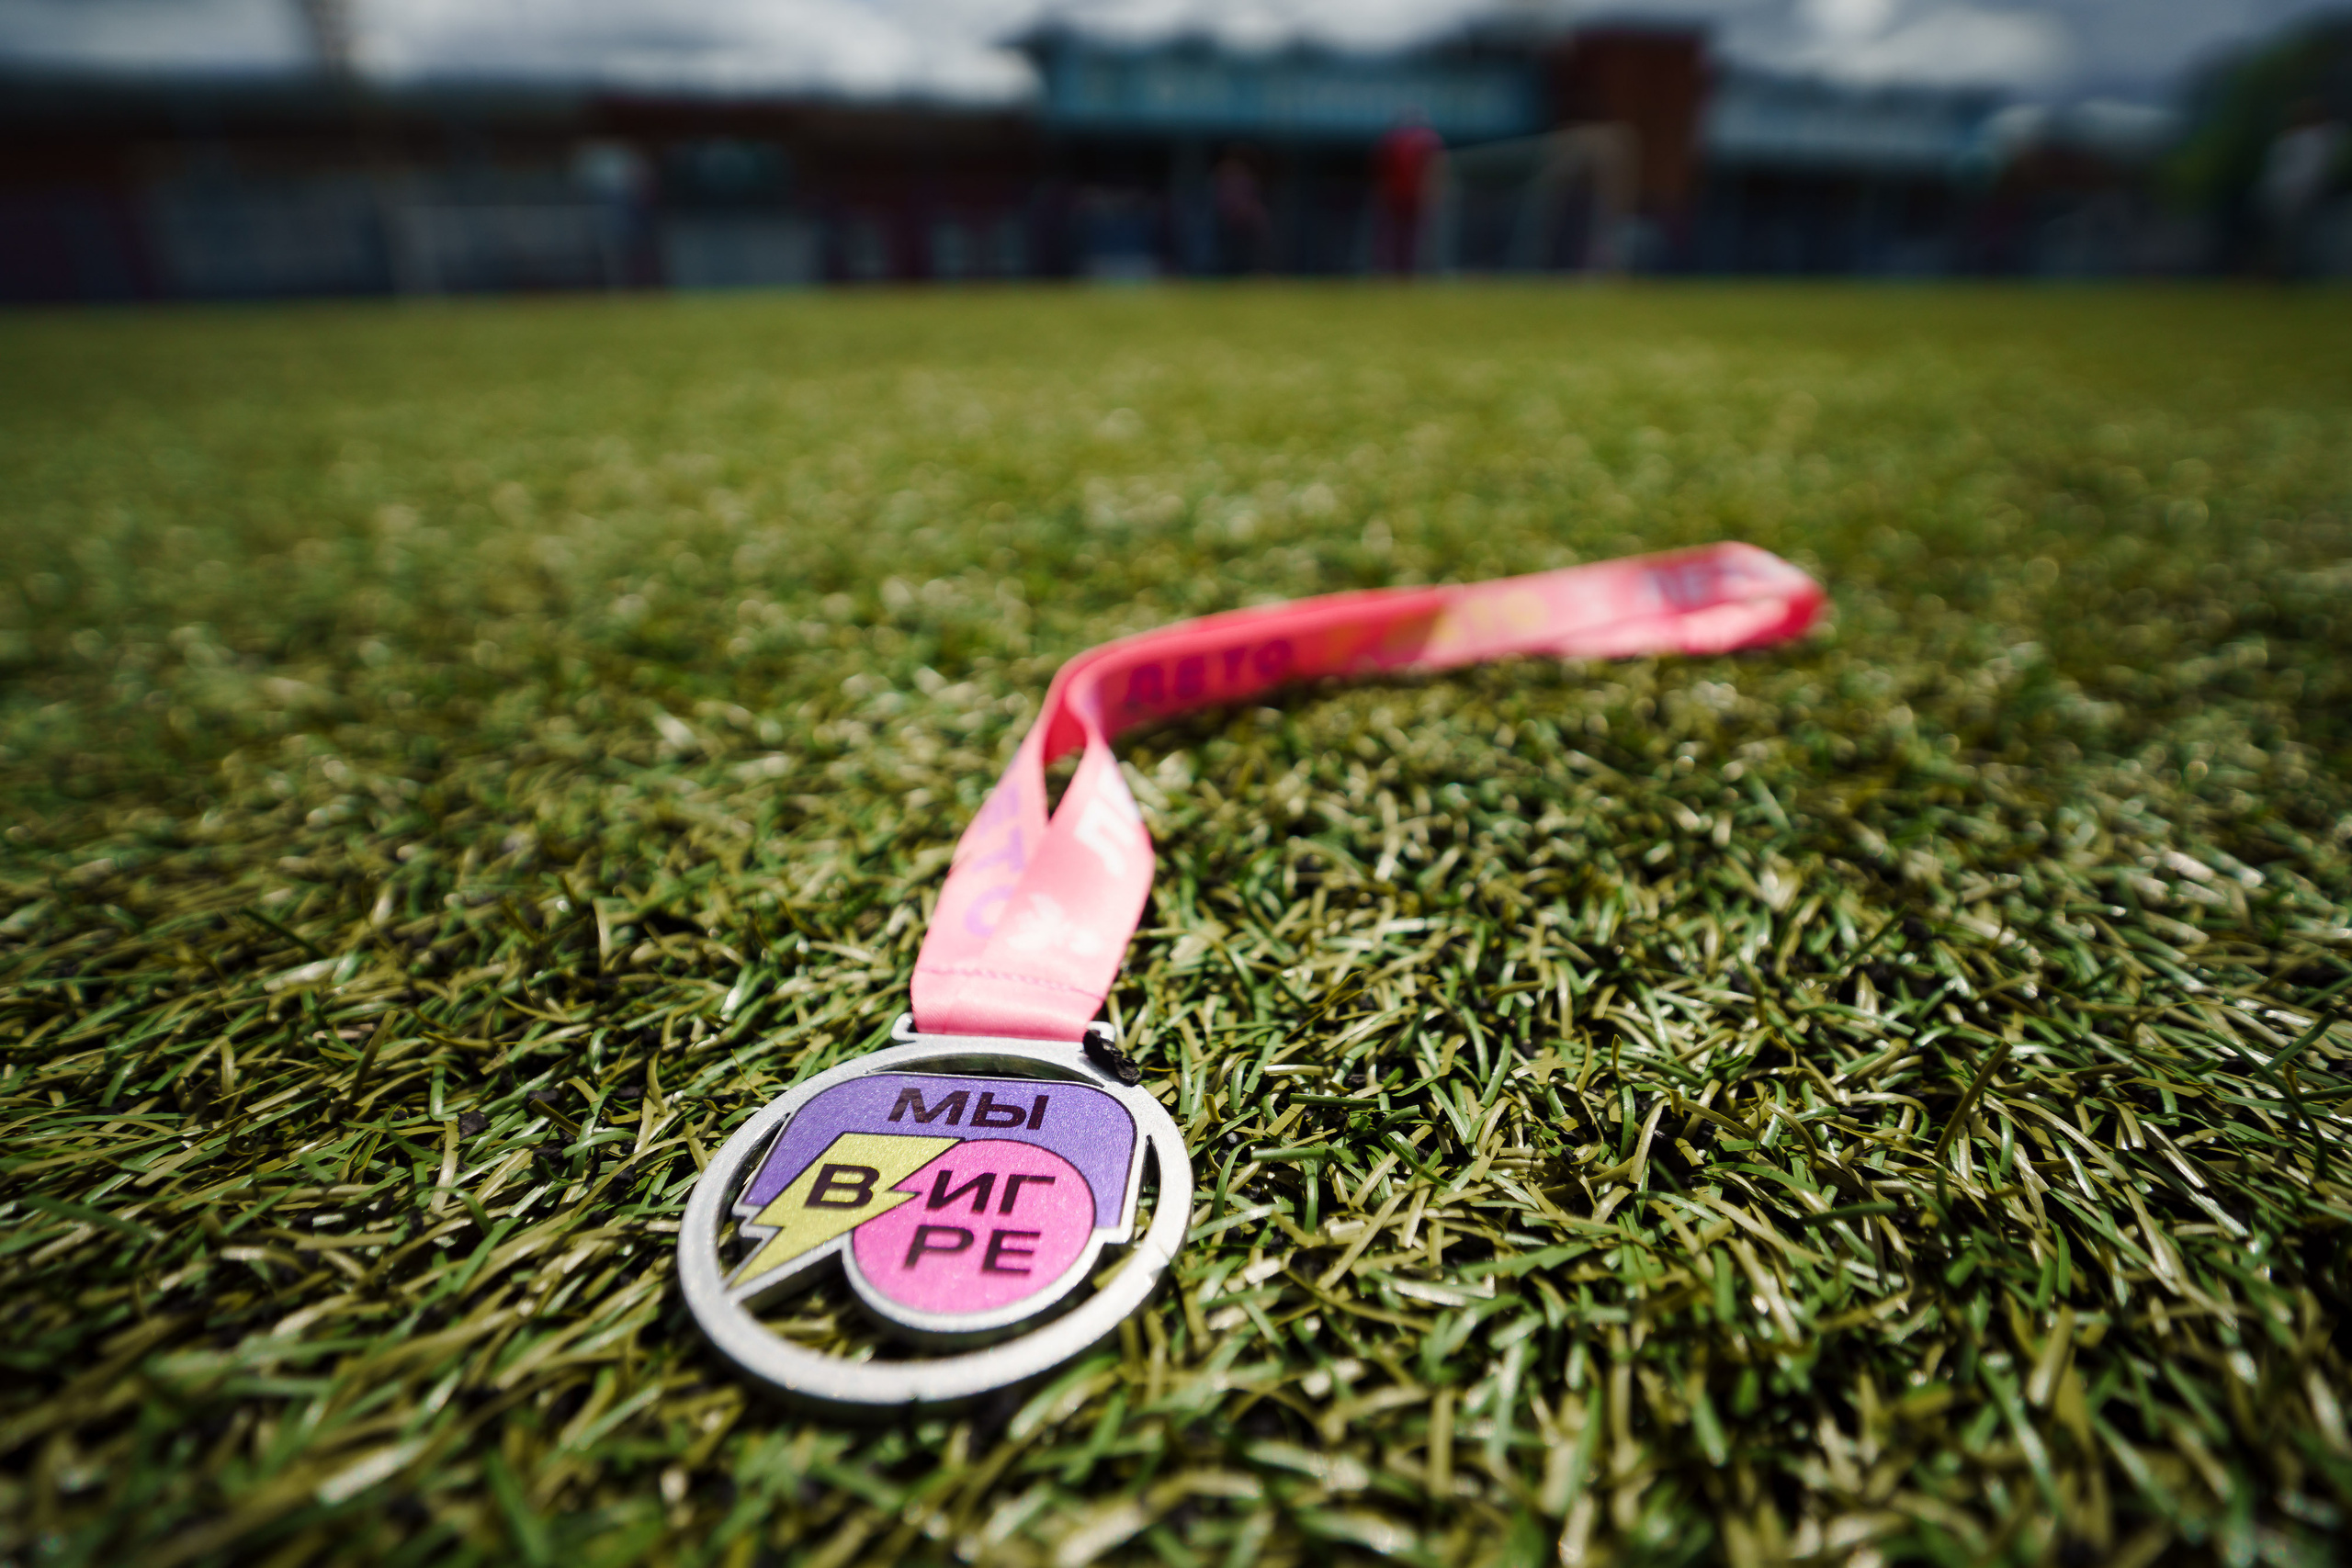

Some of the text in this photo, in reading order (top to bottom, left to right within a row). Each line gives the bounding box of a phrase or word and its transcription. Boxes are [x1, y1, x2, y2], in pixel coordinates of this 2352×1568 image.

[888, 1088, 1049, 1131] МЫ
[803, 1163, 1056, 1215] В ИГ
[903, 1224, 1041, 1274] РЕ
